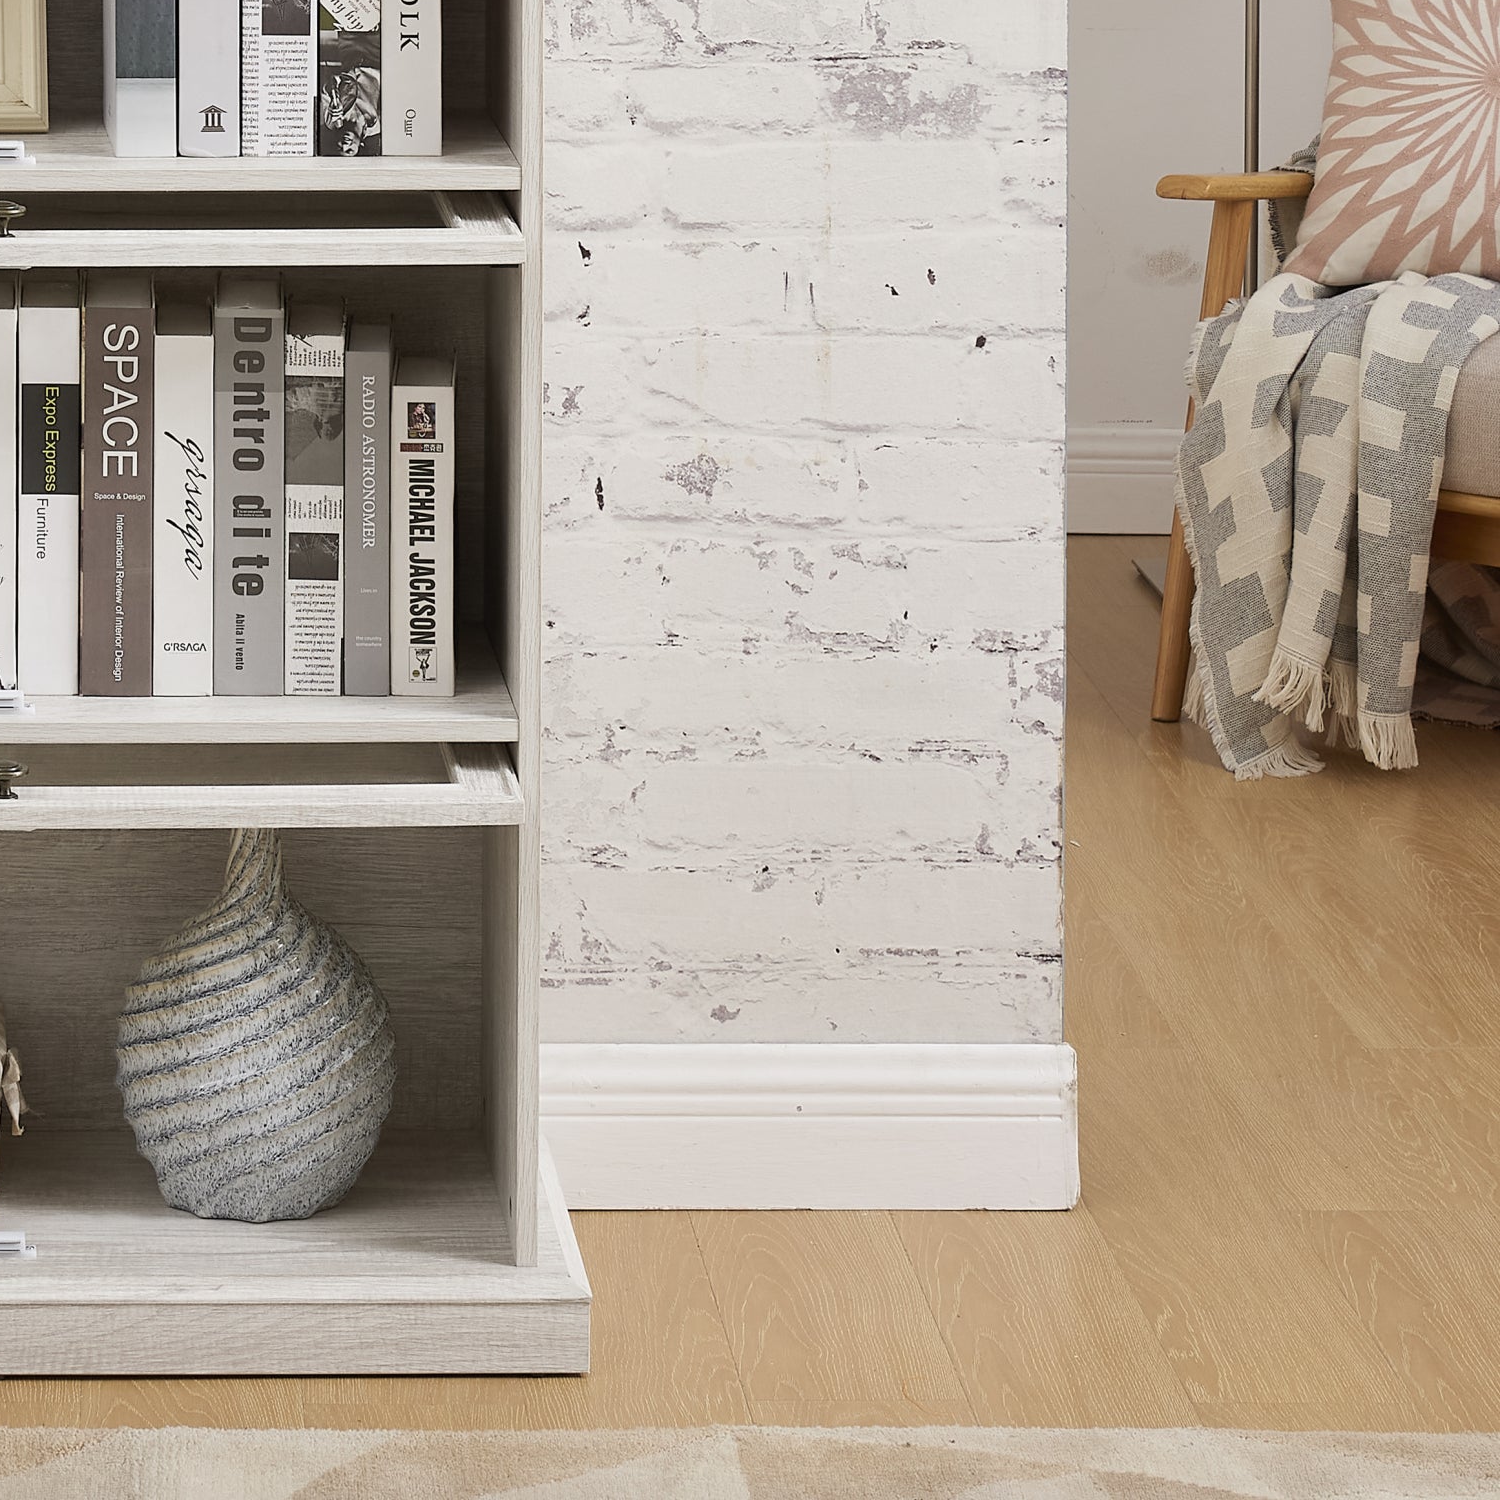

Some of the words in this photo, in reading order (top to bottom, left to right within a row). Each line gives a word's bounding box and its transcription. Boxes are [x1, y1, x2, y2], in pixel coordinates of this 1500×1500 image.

[43, 387, 59, 425] Expo
[102, 323, 139, 478] SPACE
[233, 318, 272, 472] Dentro
[362, 375, 376, 429] RADIO
[43, 429, 59, 492] Express
[94, 492, 115, 500] Space
[123, 493, 146, 501] Design
[362, 434, 376, 549] ASTRONOMER
[409, 458, 435, 547] MICHAEL
[36, 498, 49, 560] Furniture
[233, 495, 272, 538] di
[115, 514, 124, 568] International
[115, 570, 124, 603] Review
[232, 555, 270, 597] te
[409, 552, 436, 645] JACKSON
[114, 616, 124, 648] Interior
[115, 605, 124, 615] of
[112, 650, 124, 681] Design
[164, 642, 207, 651] G'RSAGA
